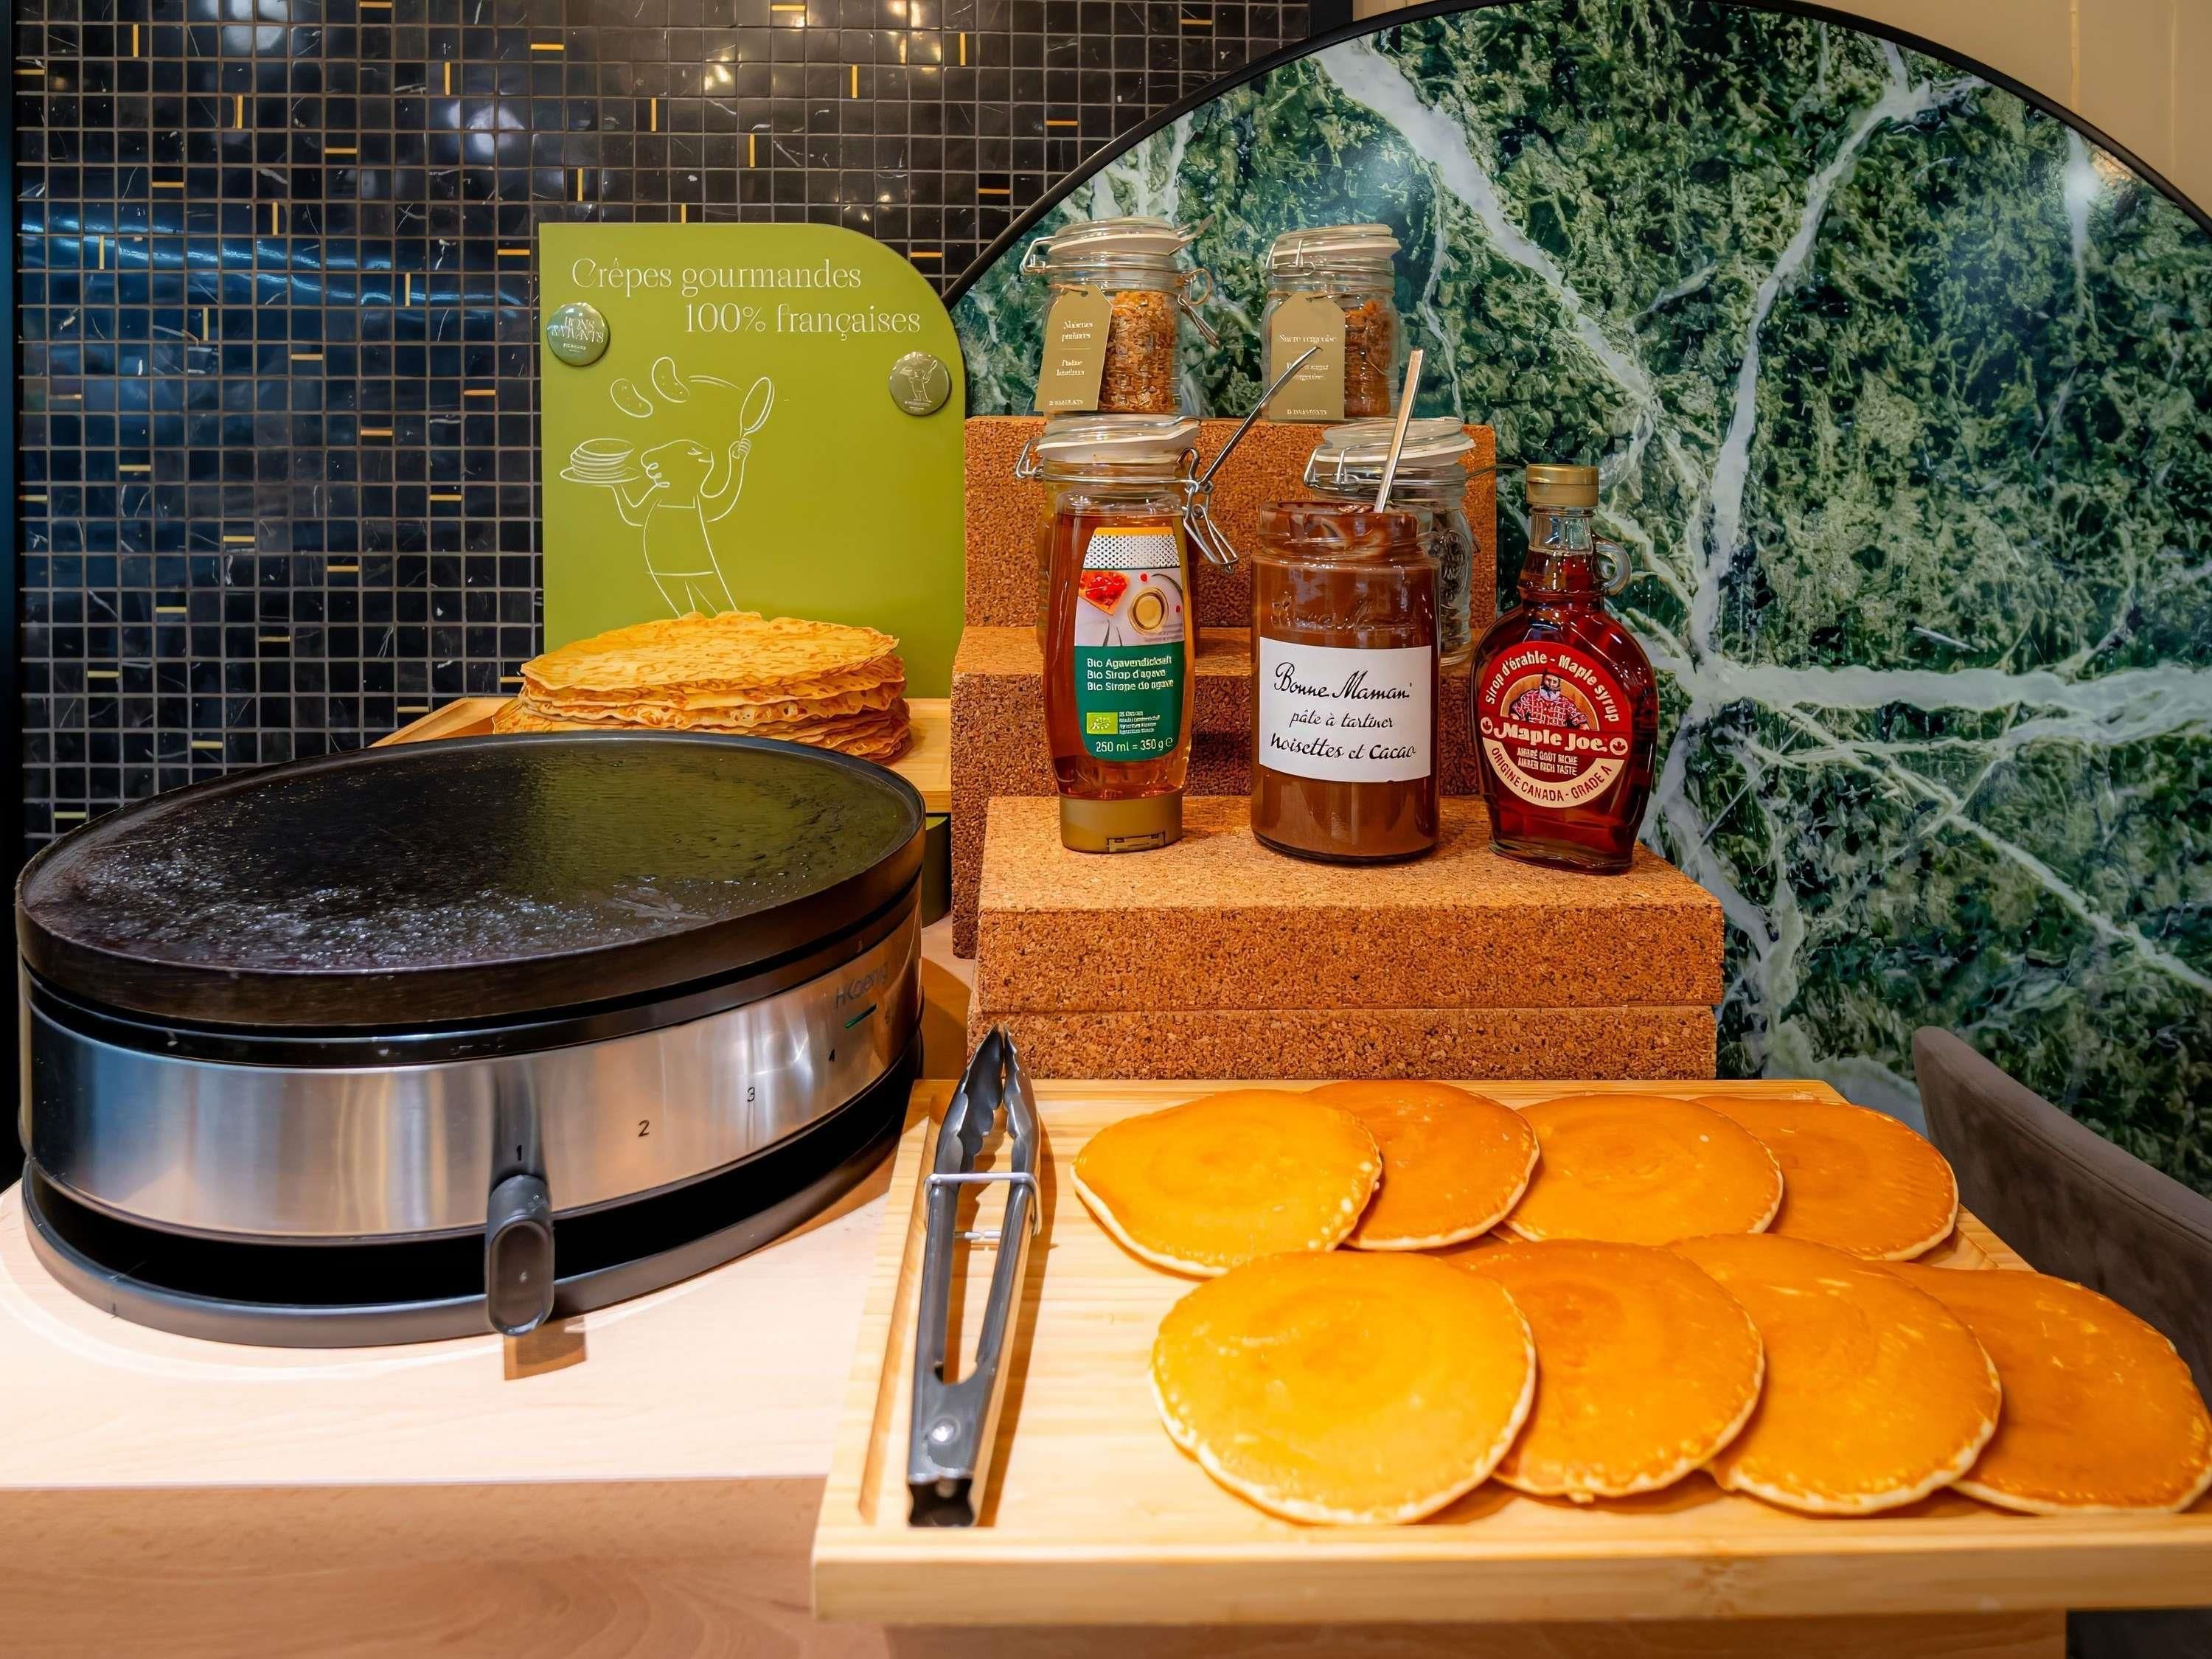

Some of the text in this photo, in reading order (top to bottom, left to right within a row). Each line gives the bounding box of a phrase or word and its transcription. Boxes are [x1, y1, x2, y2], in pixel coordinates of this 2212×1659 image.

[571, 257, 862, 298] Crêpes gourmandes
[684, 302, 921, 341] 100% françaises
[1087, 658, 1103, 667] Bio
[1087, 670, 1103, 679] Bio
[1273, 662, 1411, 700] Bonne Maman
[1087, 682, 1103, 691] Bio
[1502, 650, 1548, 676] d'érable
[1558, 654, 1598, 686] Maple
[1594, 684, 1620, 723] syrup
[1289, 710, 1394, 728] pâte à tartiner
[1096, 741, 1114, 752] 250
[1117, 741, 1130, 751] ml
[1140, 739, 1157, 751] 350
[1493, 722, 1608, 753] Maple Joe
[1348, 744, 1365, 759] et
[1492, 747, 1521, 787] ORIGINE
[1521, 781, 1564, 801] CANADA
[1571, 774, 1605, 799] GRADE
[1557, 764, 1578, 776] TASTE
[747, 1087, 756, 1102] 3
[638, 1119, 650, 1137] 2
[516, 1144, 522, 1161] 1
